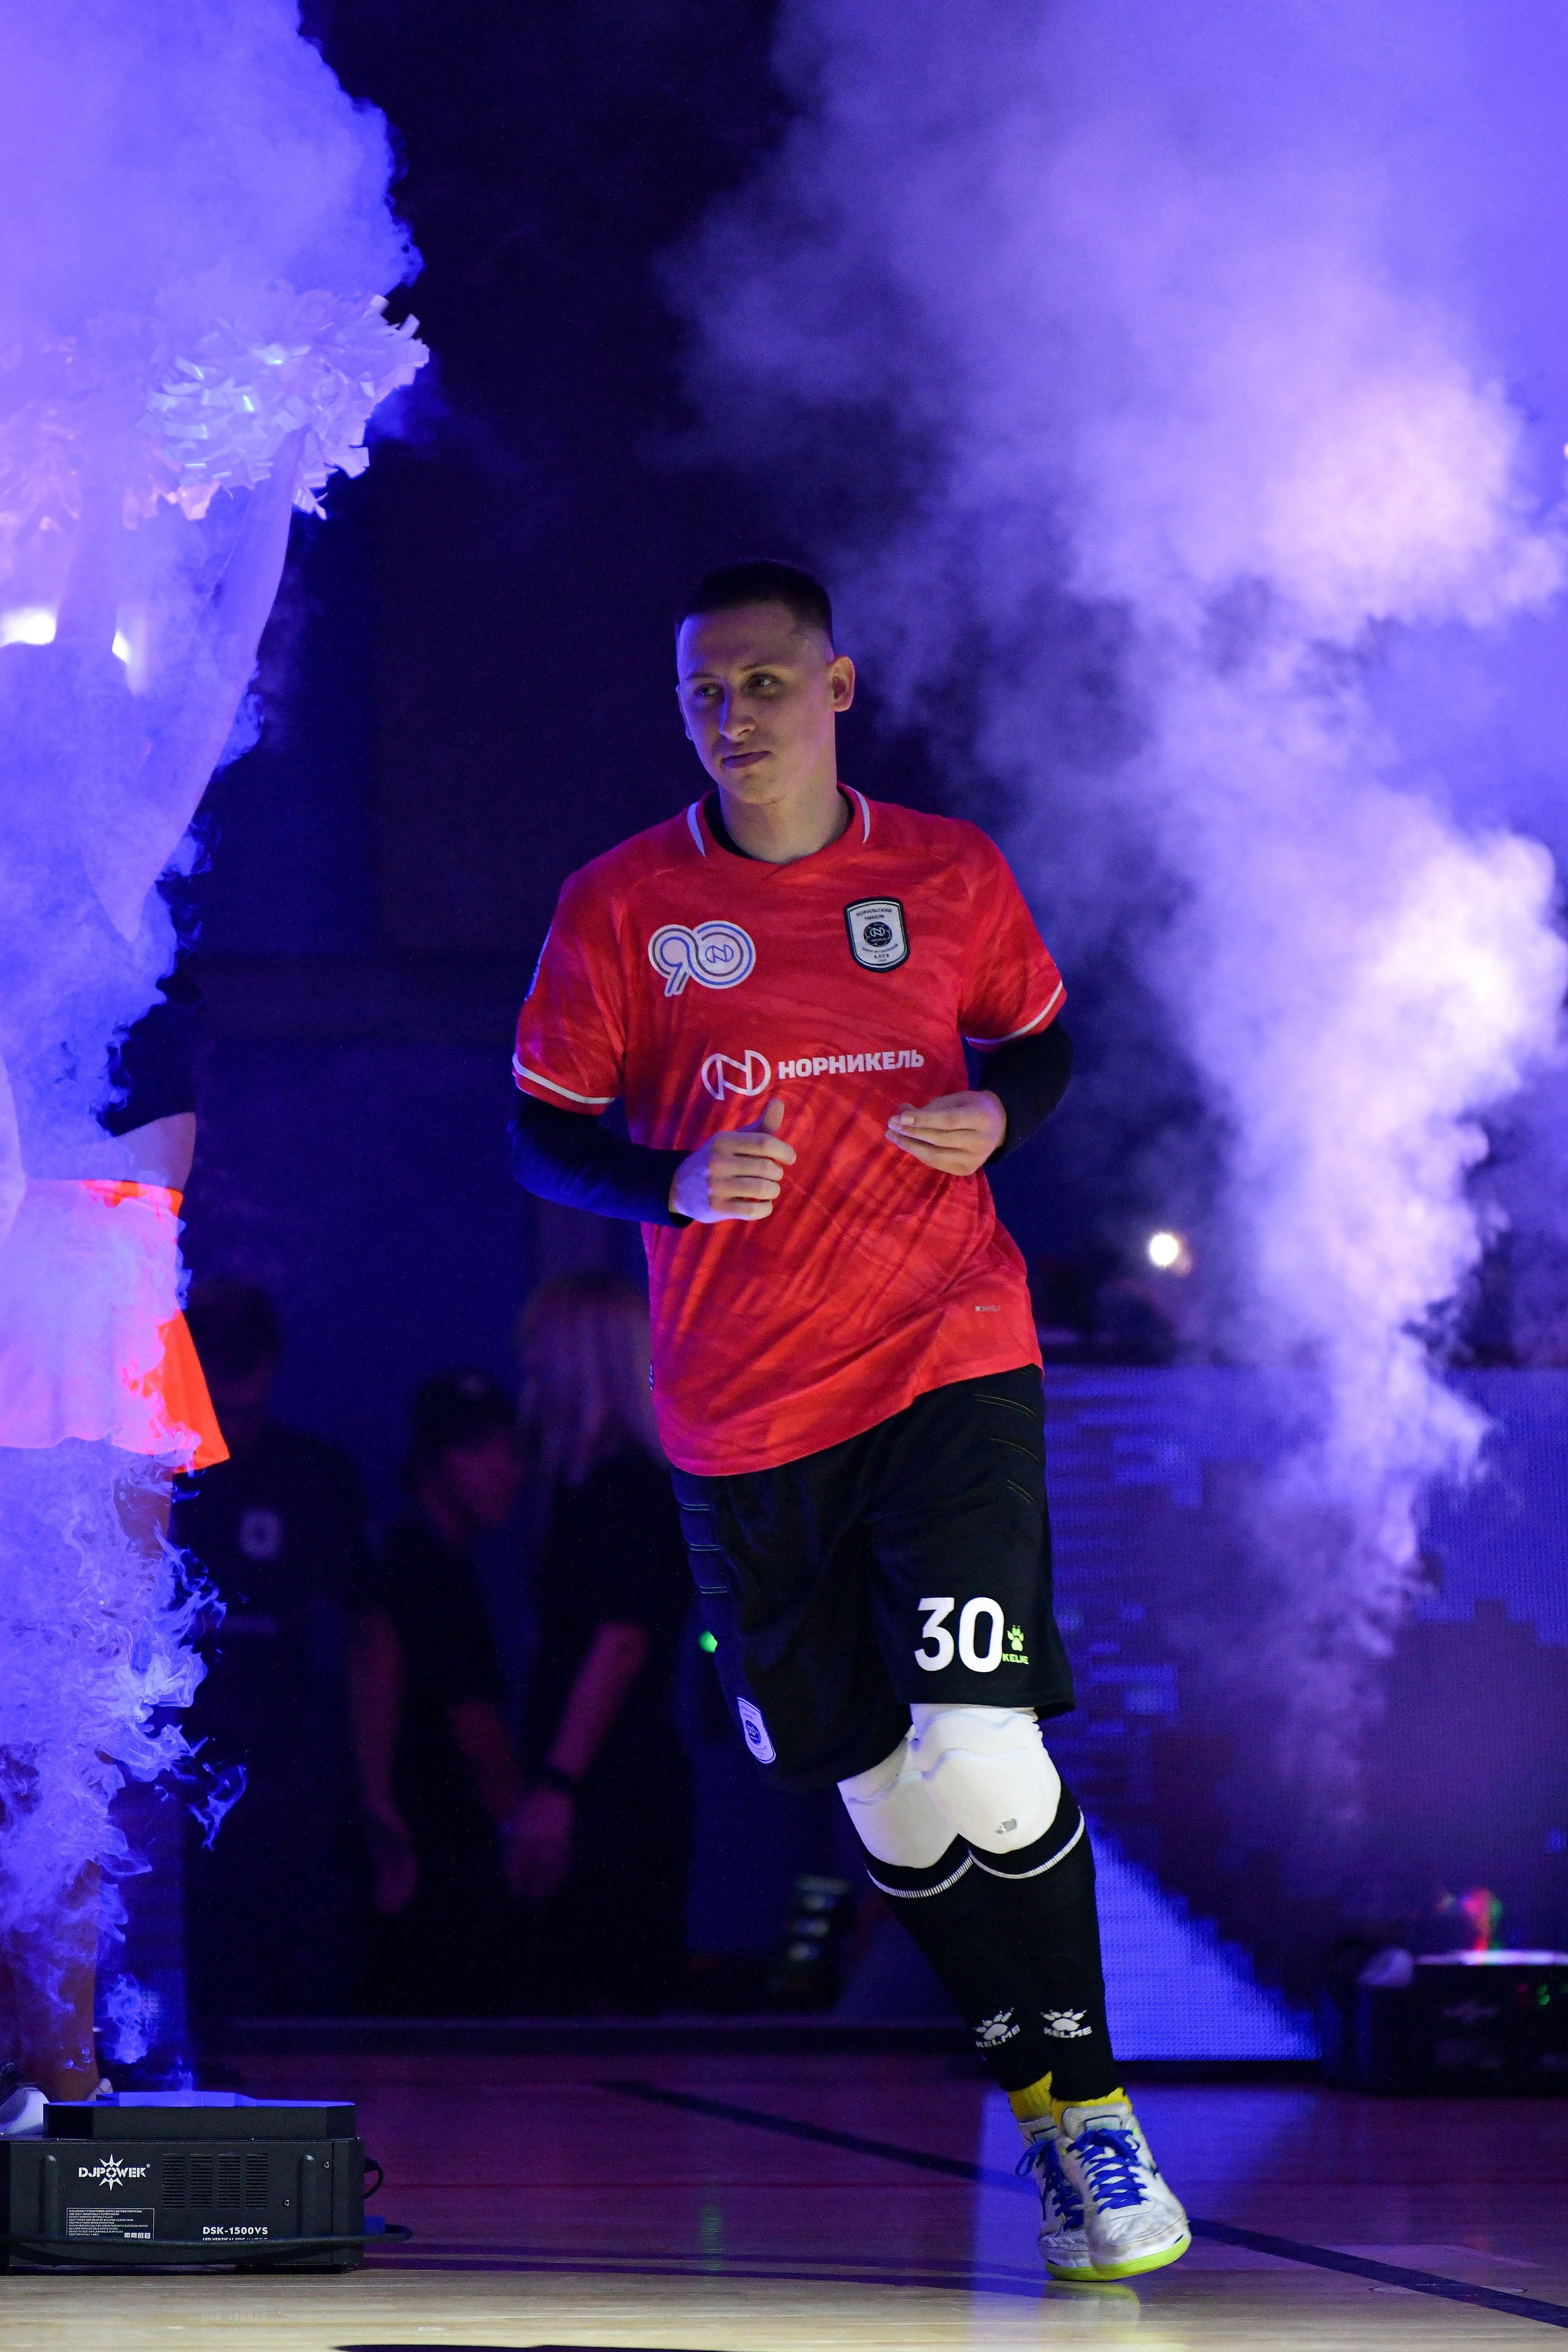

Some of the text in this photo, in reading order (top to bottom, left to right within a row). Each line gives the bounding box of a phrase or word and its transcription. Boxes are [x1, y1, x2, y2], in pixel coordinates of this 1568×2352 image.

[778, 1049, 924, 1079] НОРНИКЕЛЬ
[914, 1597, 1005, 1673] 30
[78, 2167, 146, 2177] DJPOWER
